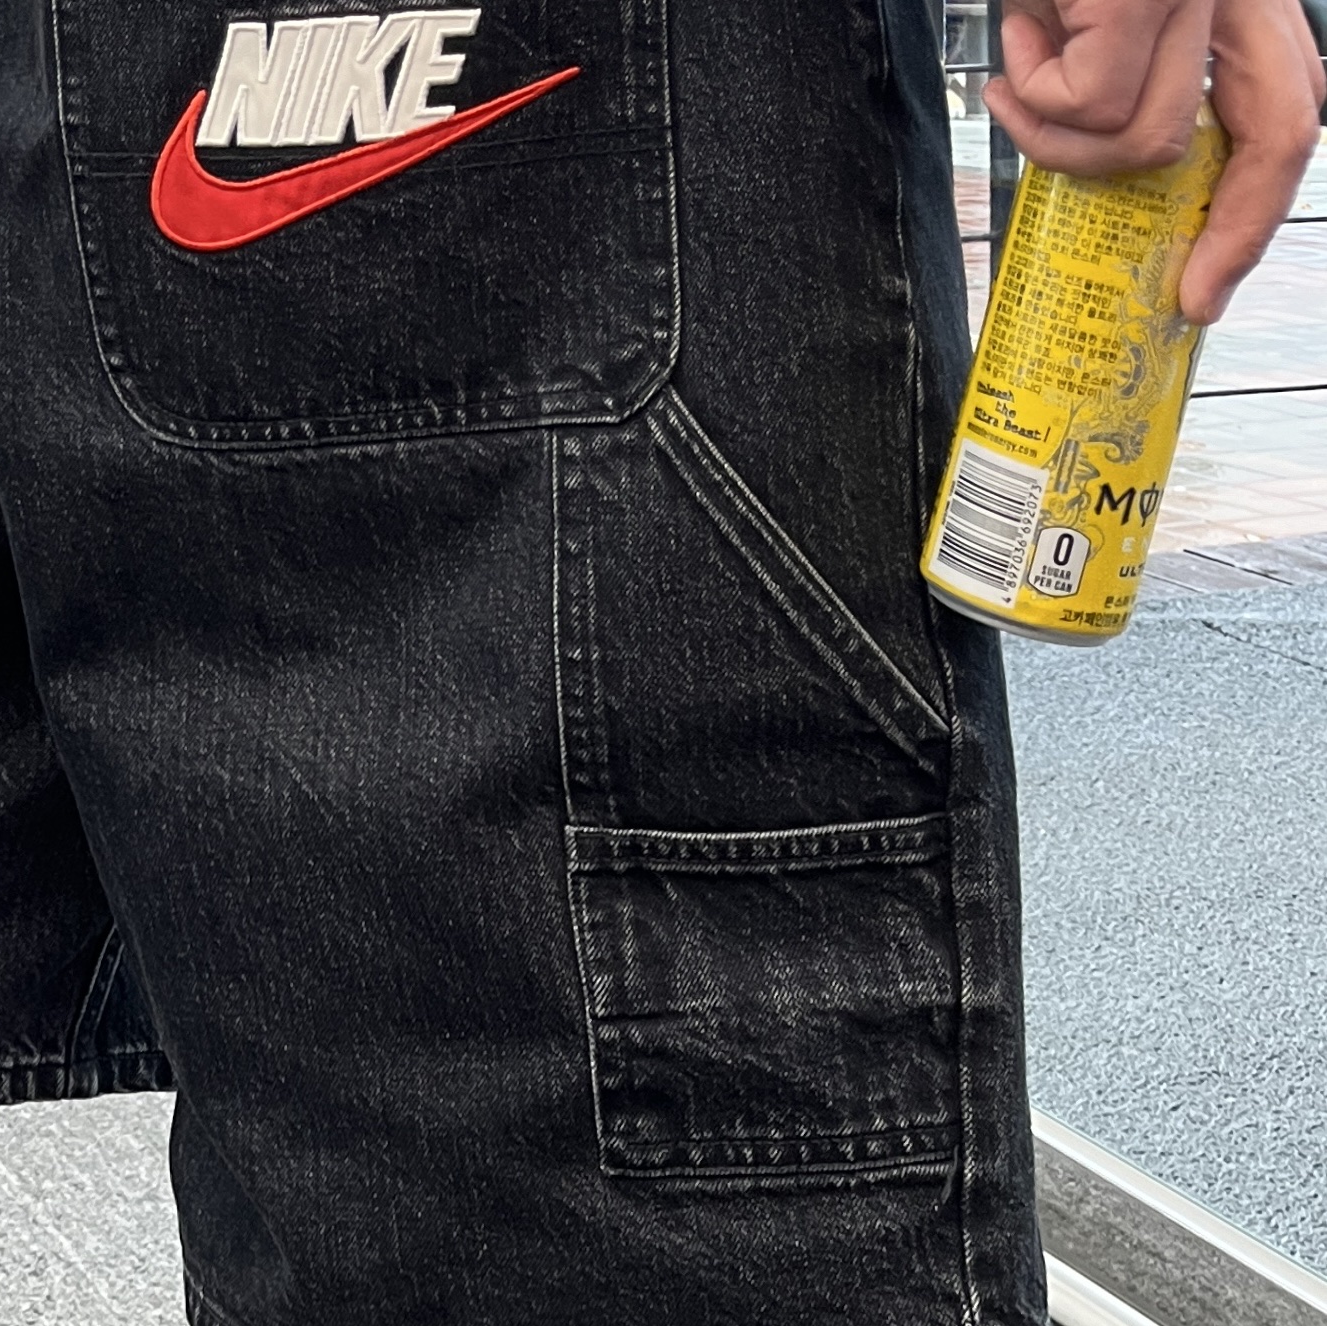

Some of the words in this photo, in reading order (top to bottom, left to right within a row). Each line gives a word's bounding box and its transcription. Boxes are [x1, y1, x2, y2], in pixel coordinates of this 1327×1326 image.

[195, 8, 482, 147] NIKE
[995, 401, 1017, 418] the
[1006, 539, 1027, 588] 897036
[1023, 484, 1042, 535] 692073
[1053, 533, 1075, 566] 0
[1034, 575, 1052, 588] PER
[1054, 581, 1073, 593] CAN
[1042, 565, 1071, 580] SUGAR
